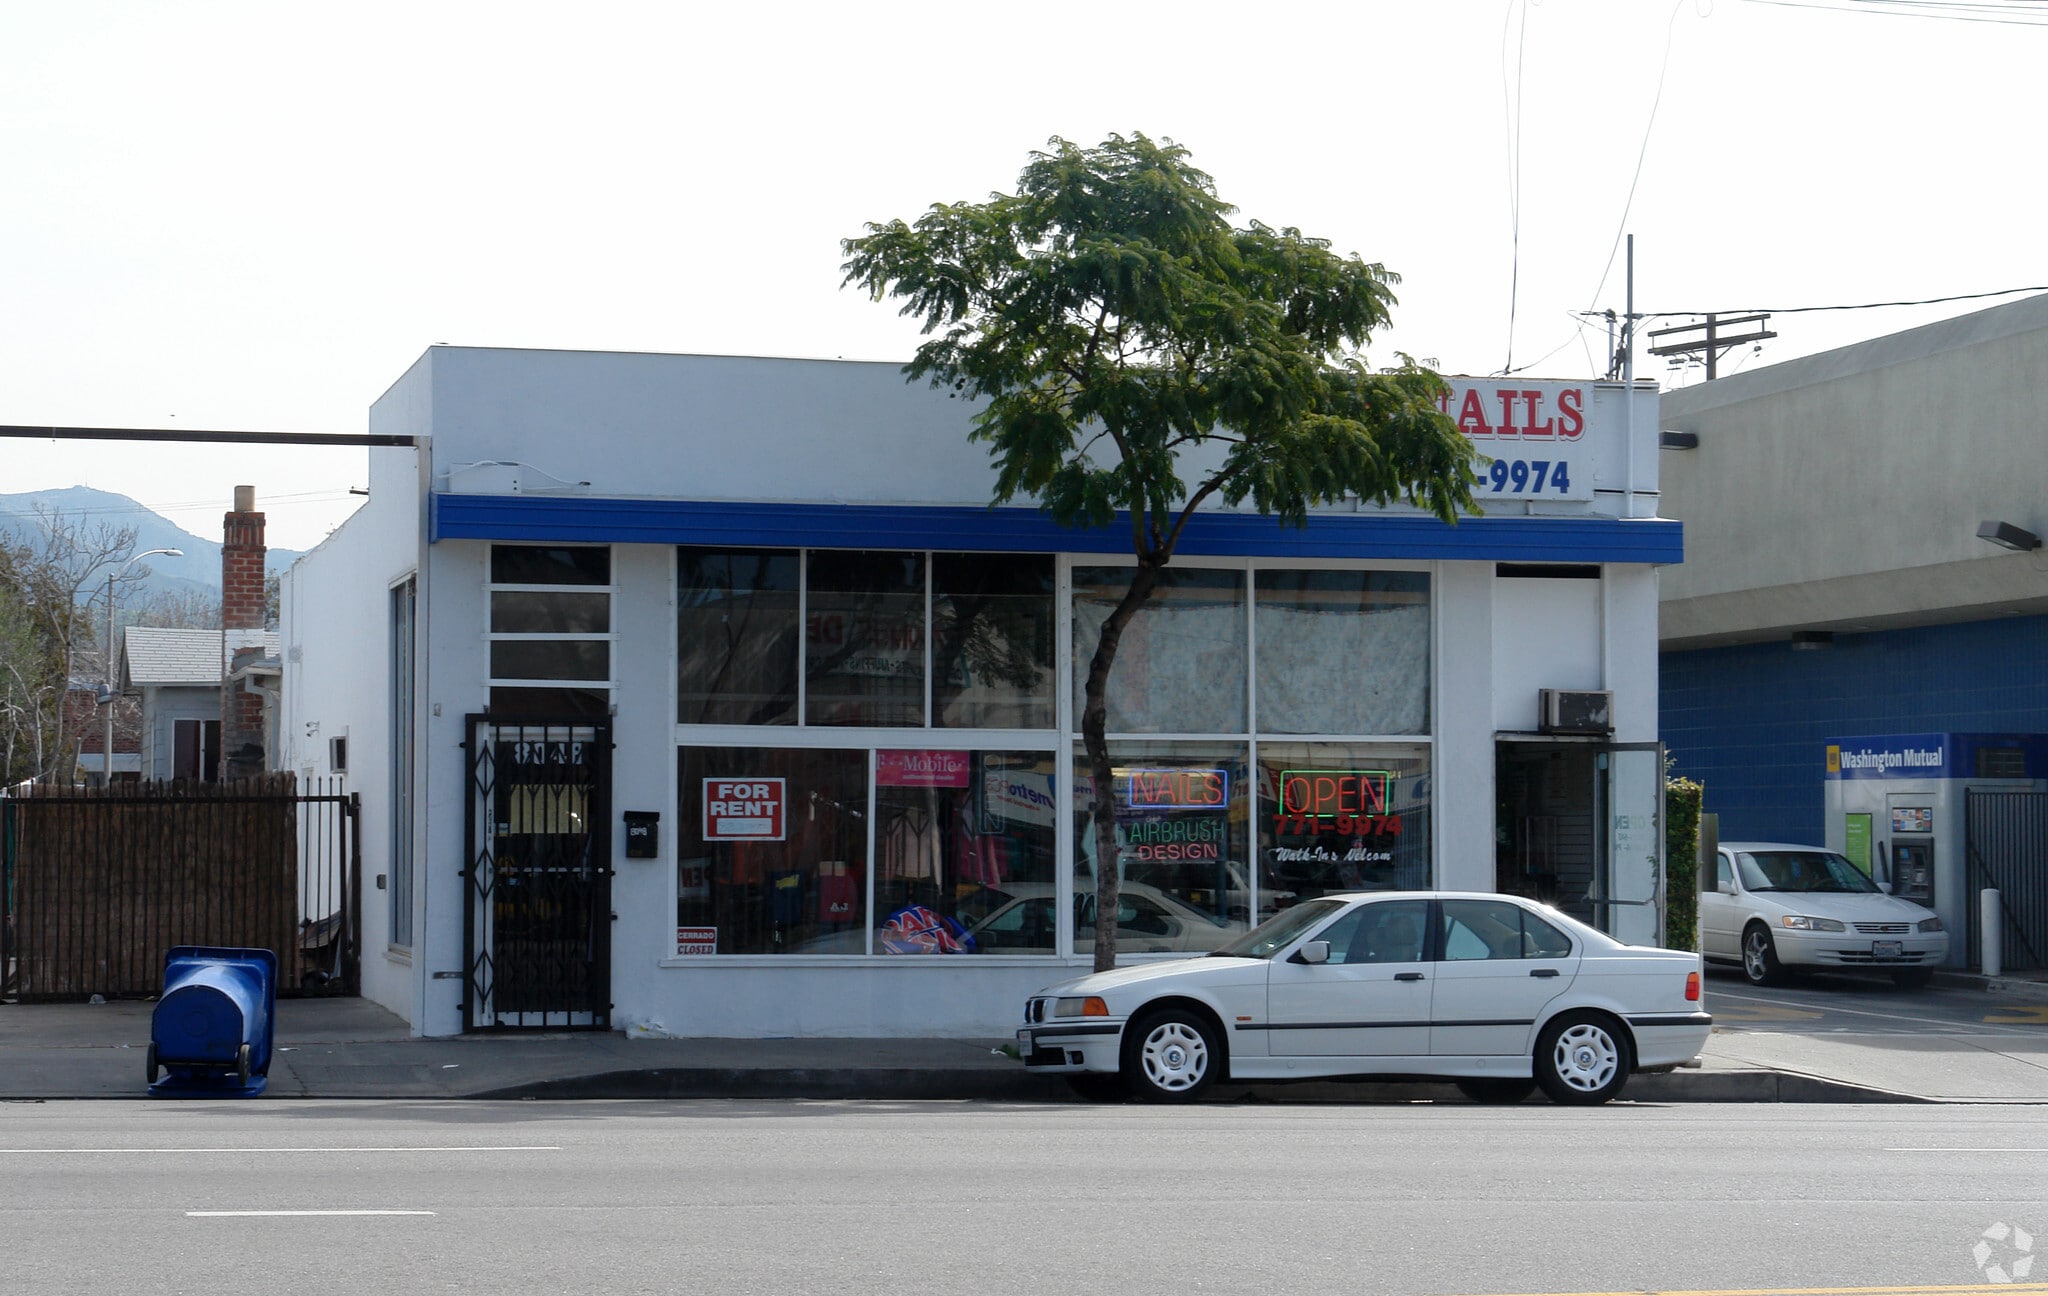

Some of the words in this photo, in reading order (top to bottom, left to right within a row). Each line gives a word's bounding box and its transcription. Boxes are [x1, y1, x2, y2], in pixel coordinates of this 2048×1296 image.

[1840, 748, 1903, 773] Washington
[1903, 746, 1943, 767] Mutual
[718, 784, 770, 799] FOR
[1133, 773, 1222, 804] NAILS
[1285, 776, 1385, 814] OPEN
[710, 801, 778, 816] RENT
[1130, 820, 1225, 843] AIRBRUSH
[1272, 814, 1403, 836] 771-9974
[1139, 843, 1218, 861] DESIGN
[678, 945, 714, 954] CLOSED
